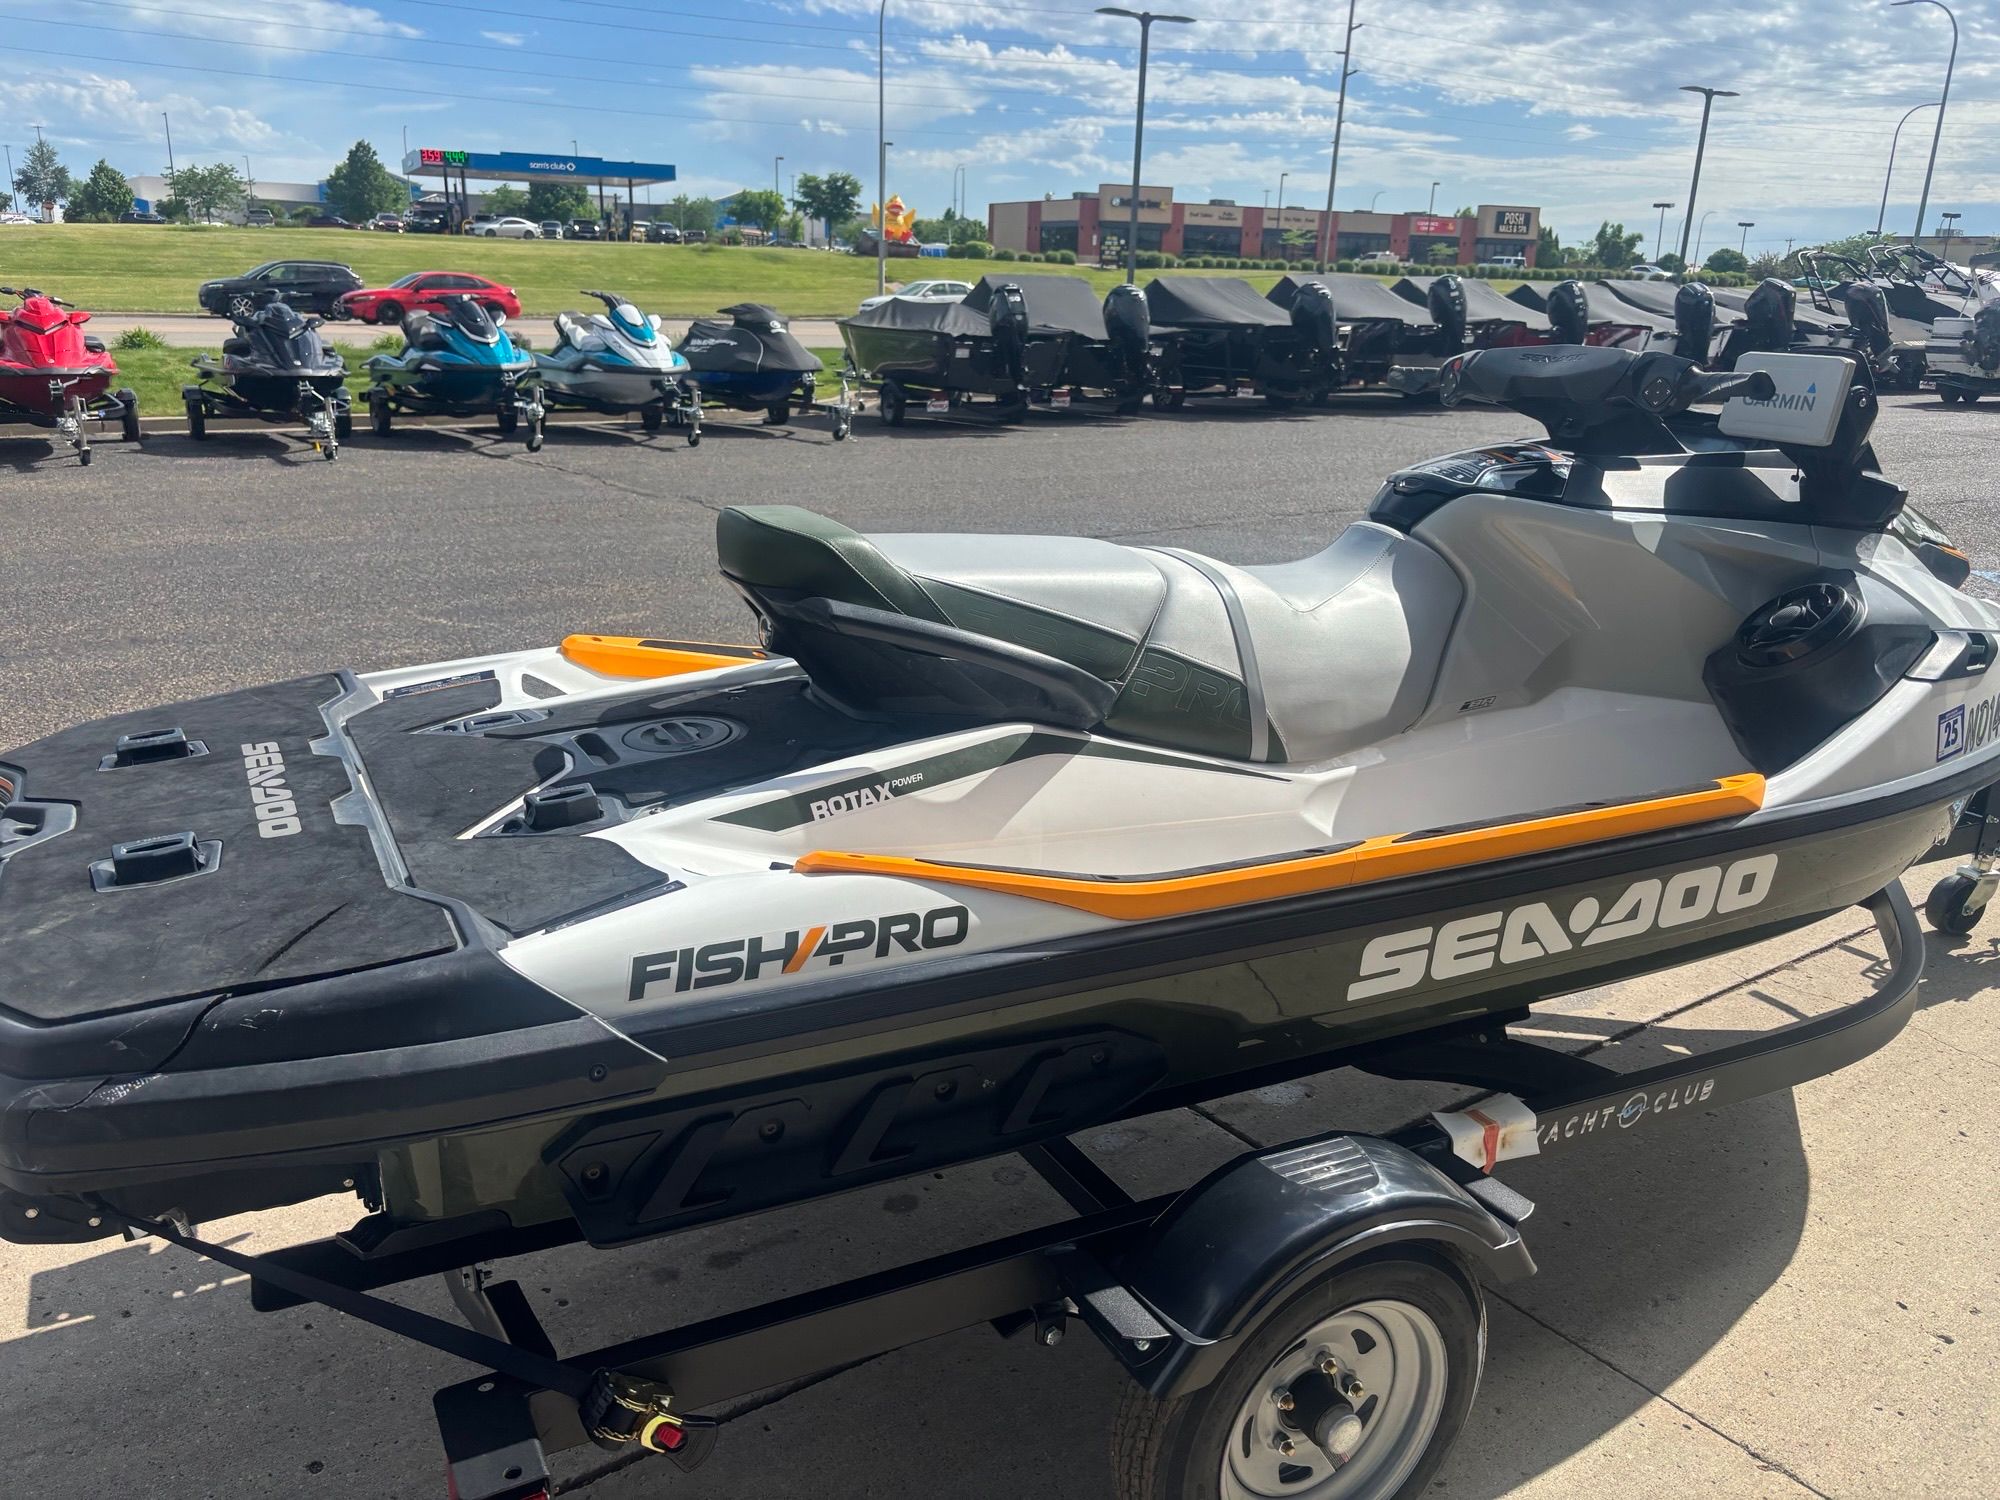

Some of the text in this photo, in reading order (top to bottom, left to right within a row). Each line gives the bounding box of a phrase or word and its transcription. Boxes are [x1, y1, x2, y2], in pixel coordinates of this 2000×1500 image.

[550, 161, 566, 171] club
[1503, 212, 1526, 225] POSH
[1943, 718, 1959, 749] 25
[809, 772, 923, 821] ROTAX POWER
[1653, 1078, 1715, 1114] CLUB
